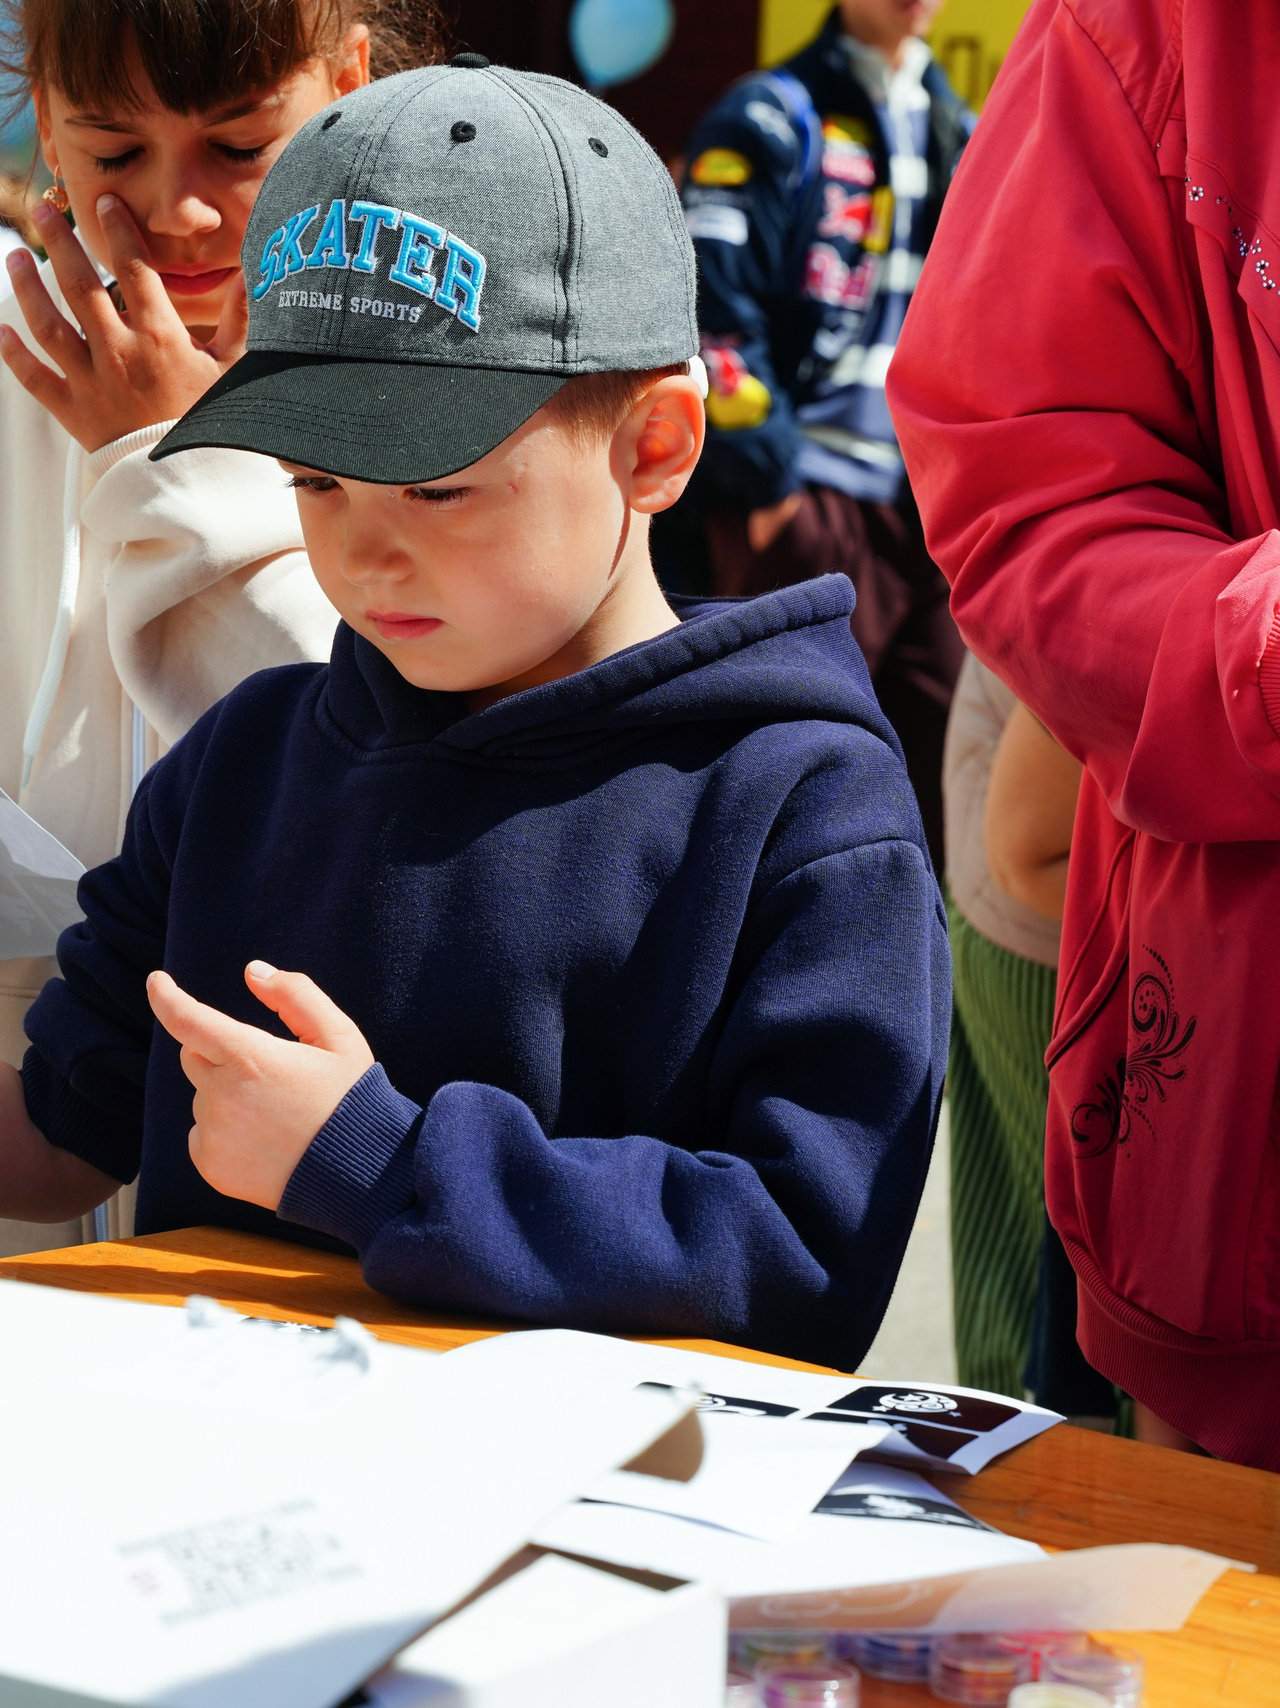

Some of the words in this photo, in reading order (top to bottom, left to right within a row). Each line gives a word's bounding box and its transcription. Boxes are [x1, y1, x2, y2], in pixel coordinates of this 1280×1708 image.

[253, 199, 487, 333] SKATER
[278, 290, 343, 311] EXTREME
[350, 297, 421, 323] SPORTS
